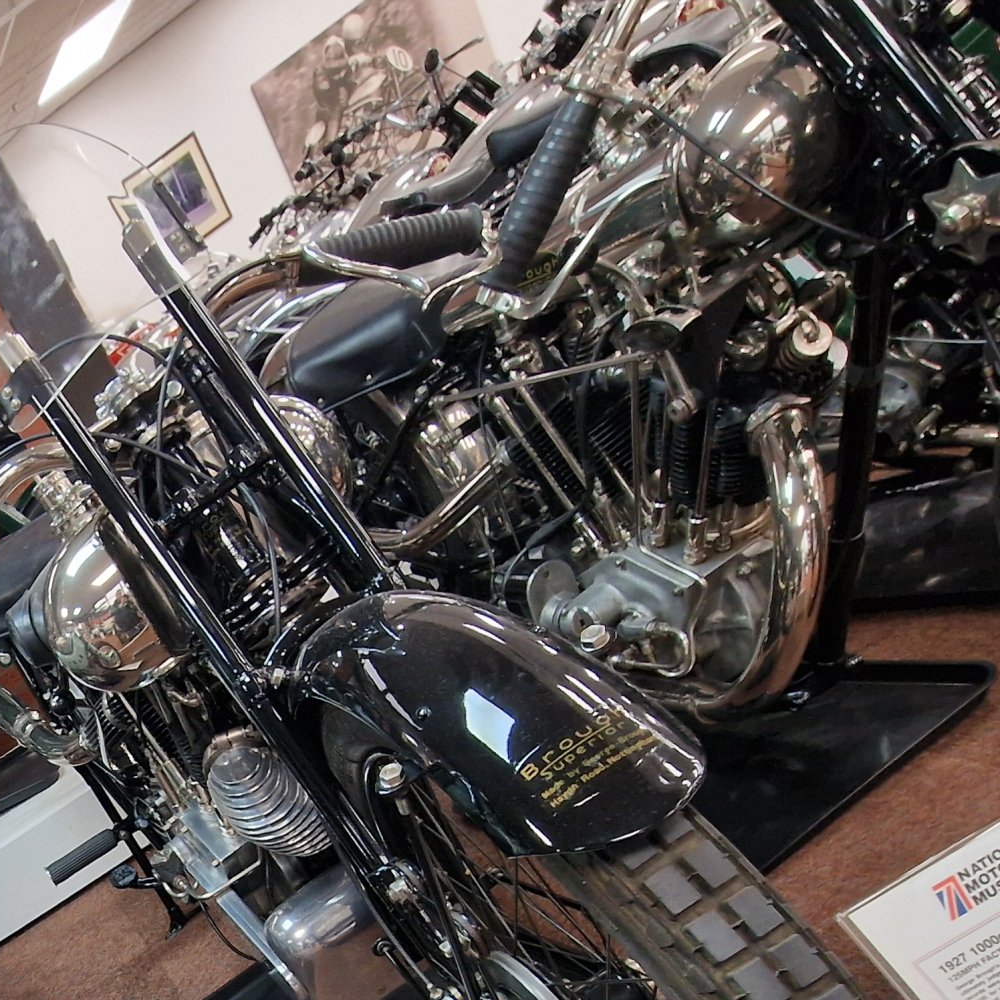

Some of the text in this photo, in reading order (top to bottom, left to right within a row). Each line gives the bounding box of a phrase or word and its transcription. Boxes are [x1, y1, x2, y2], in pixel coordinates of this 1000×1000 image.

[540, 721, 626, 781] Superior
[939, 934, 1000, 974] 1927 1000
[948, 962, 981, 983] 125MPH
